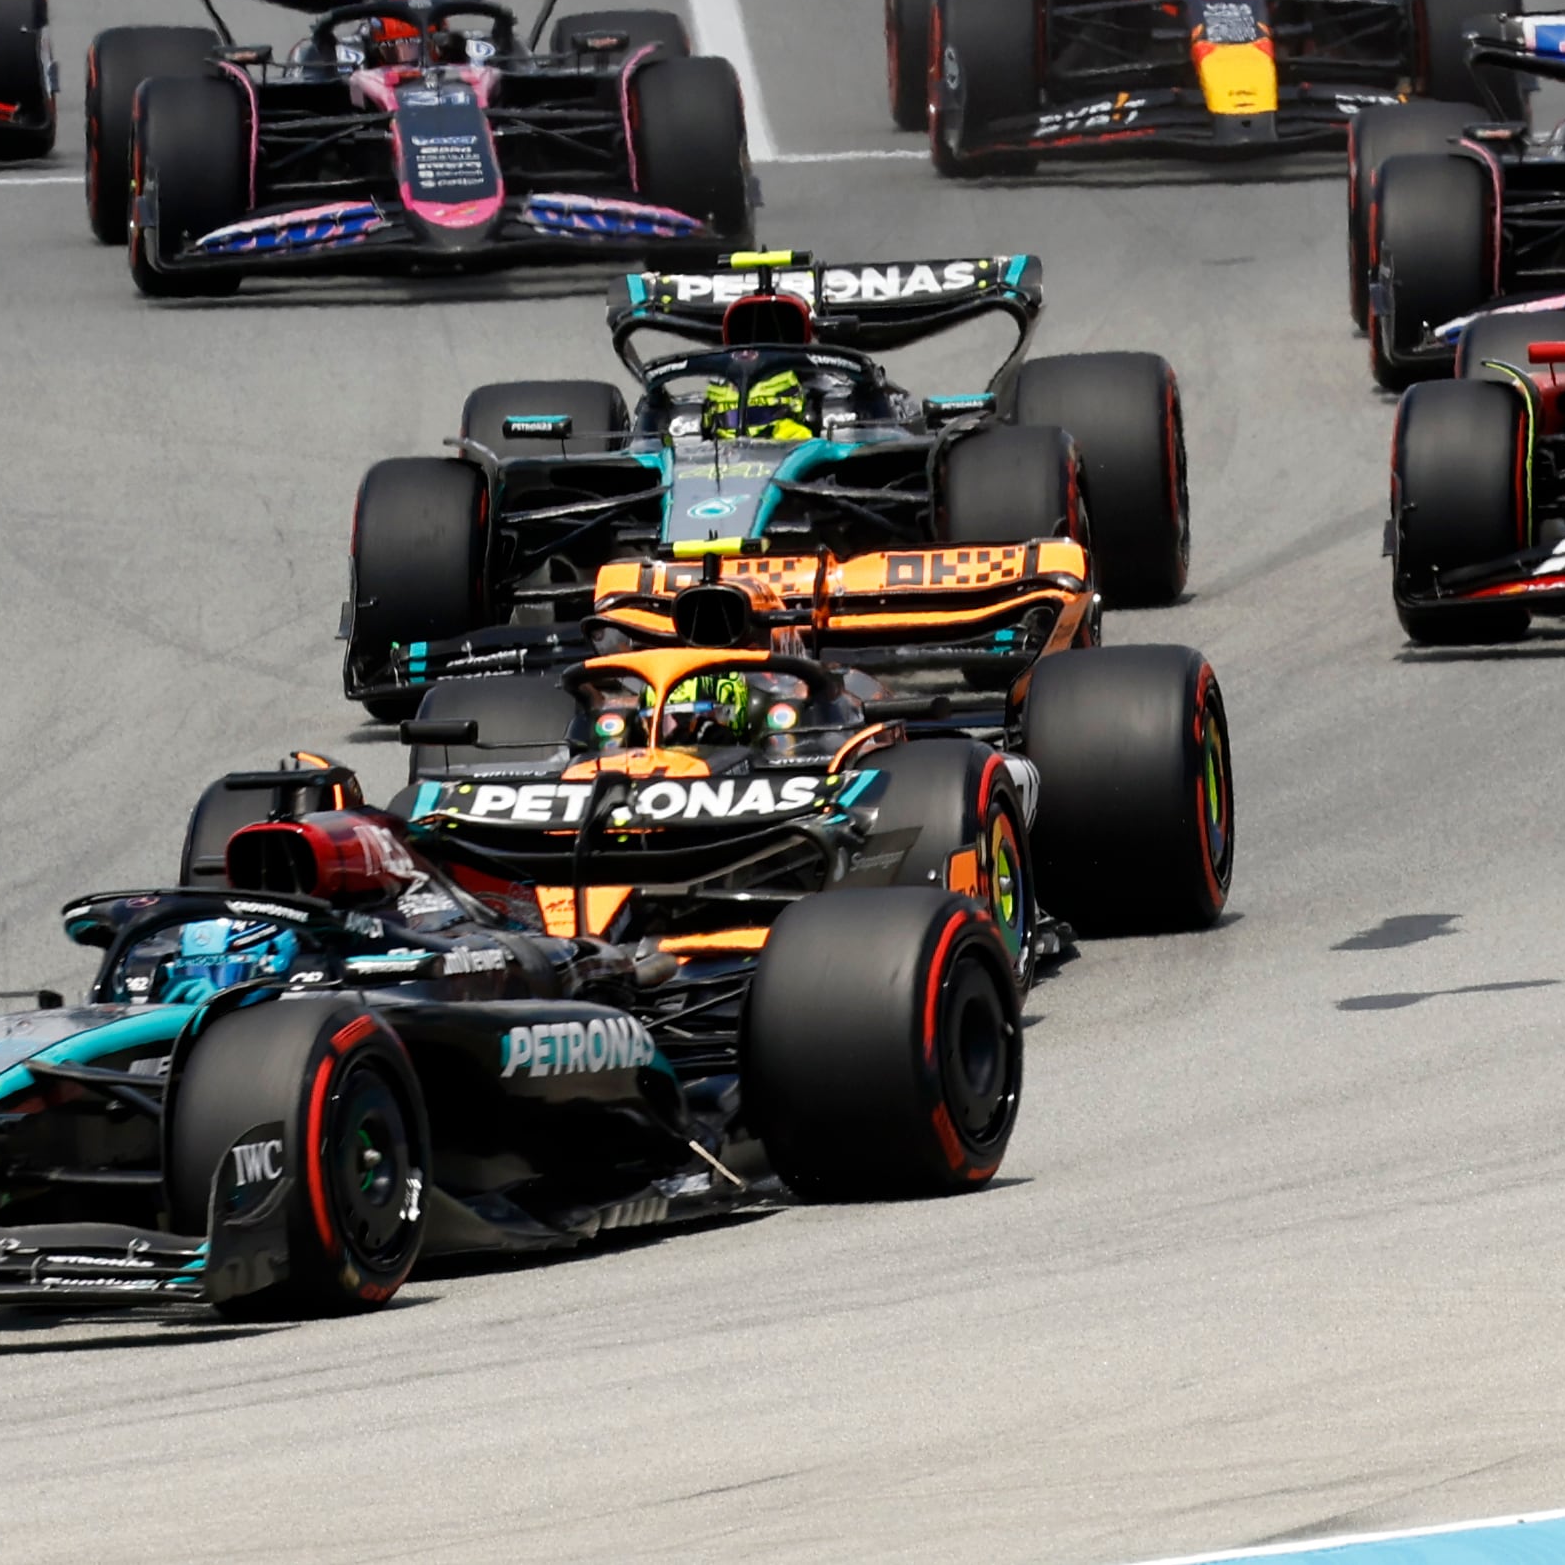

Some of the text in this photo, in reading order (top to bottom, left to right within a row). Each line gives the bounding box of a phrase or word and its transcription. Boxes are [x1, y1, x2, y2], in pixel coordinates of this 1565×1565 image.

[468, 775, 821, 823] PETONAS
[500, 1015, 656, 1079] PETRONAS
[231, 1138, 283, 1187] IWC
